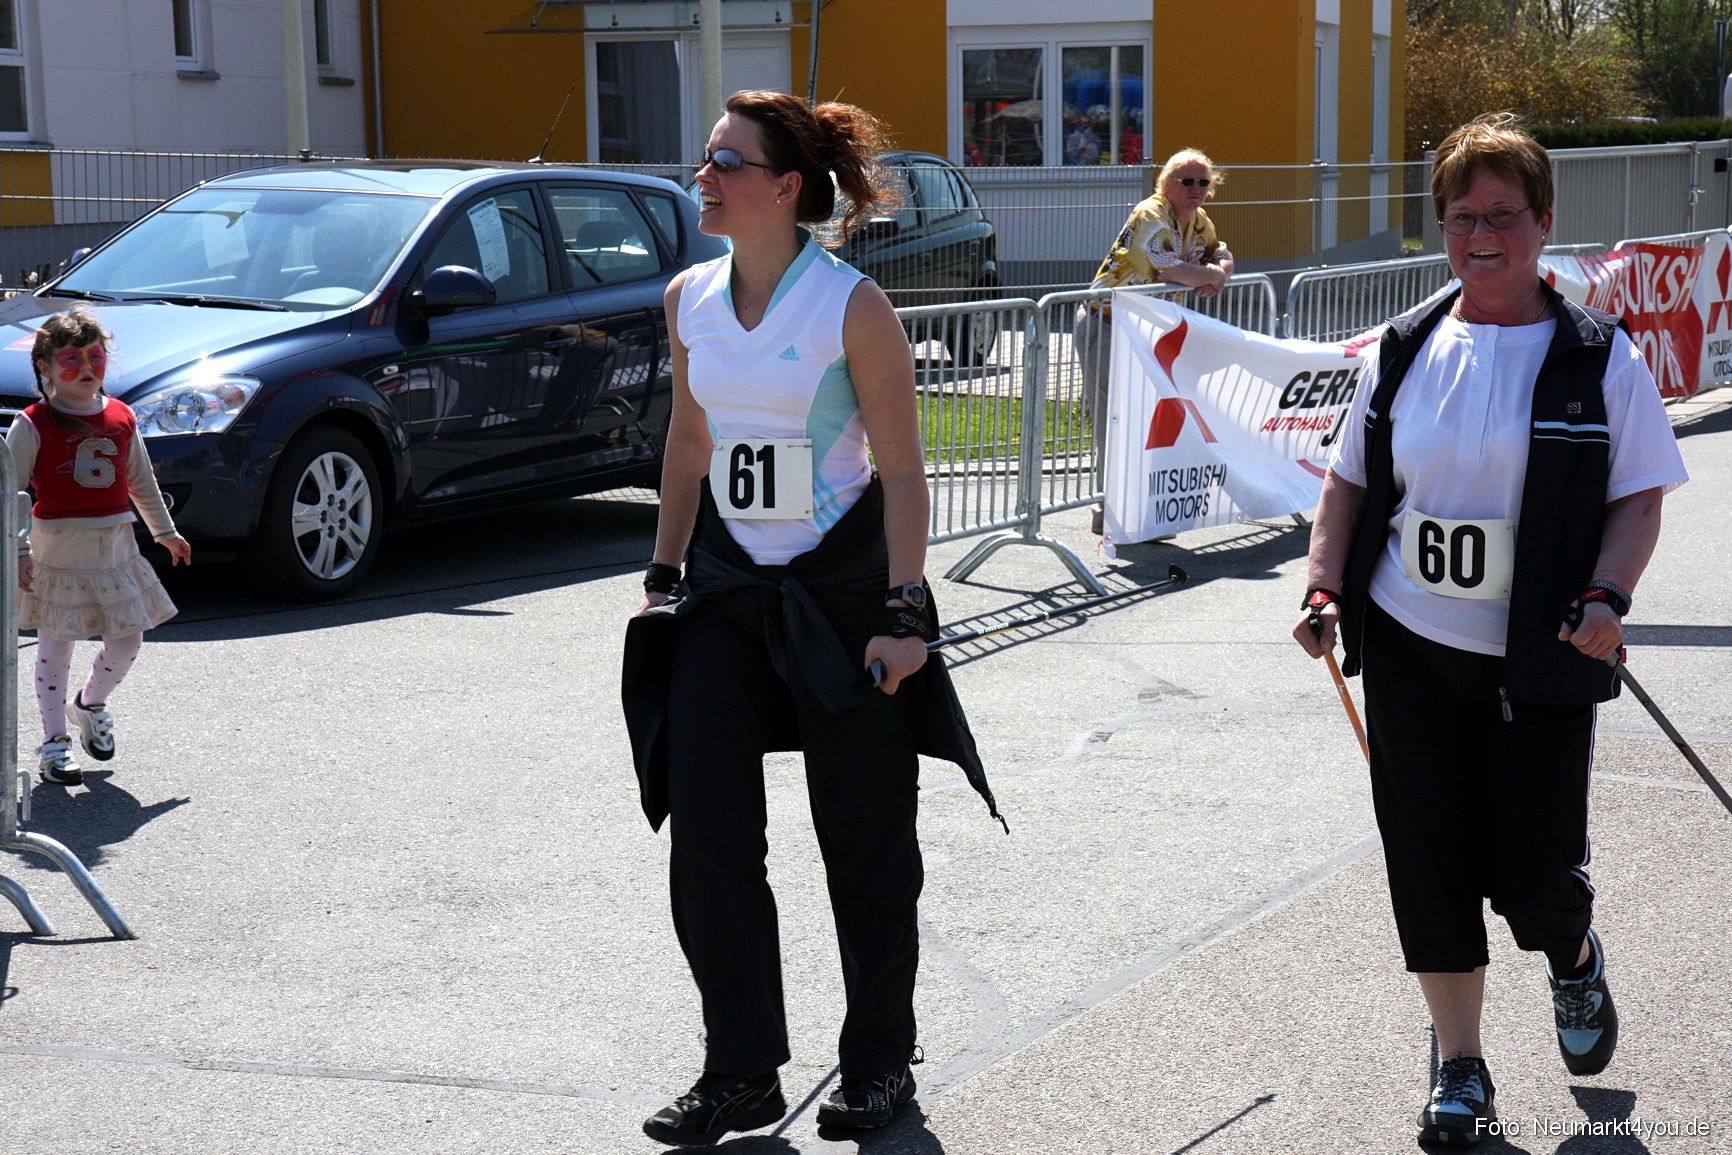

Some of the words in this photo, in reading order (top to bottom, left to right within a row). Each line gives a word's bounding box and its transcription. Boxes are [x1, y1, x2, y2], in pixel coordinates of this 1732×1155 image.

[1260, 414, 1335, 432] AUTOHAUS
[1321, 408, 1348, 447] J
[74, 438, 118, 488] 6
[729, 443, 776, 510] 61
[1148, 463, 1227, 497] MITSUBISHI
[1155, 492, 1211, 525] MOTORS
[1418, 520, 1486, 588] 60
